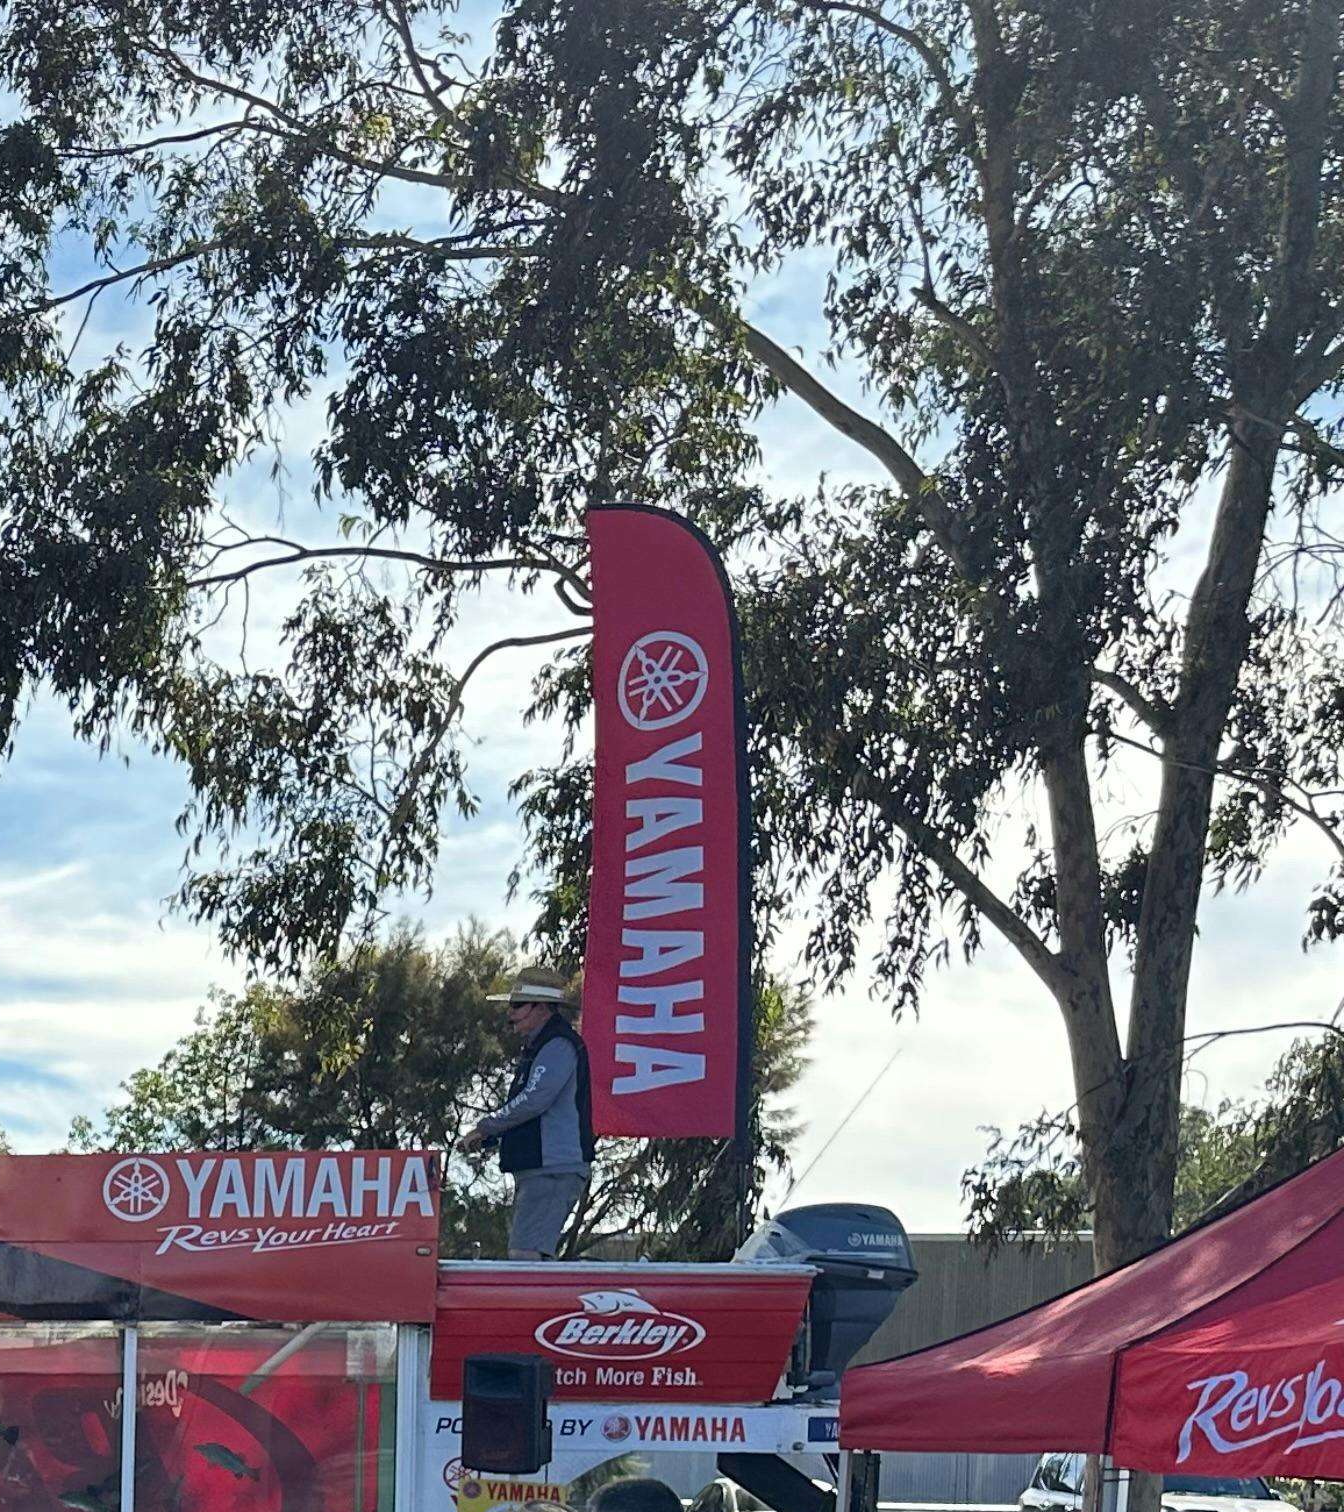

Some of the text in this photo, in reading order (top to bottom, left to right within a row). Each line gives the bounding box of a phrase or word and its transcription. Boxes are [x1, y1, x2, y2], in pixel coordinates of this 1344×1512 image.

[612, 731, 706, 1094] YAMAHA
[176, 1157, 434, 1219] YAMAHA
[156, 1220, 401, 1255] Revs Your Heart
[862, 1233, 904, 1247] YAMAHA
[554, 1318, 689, 1355] Berkley
[555, 1368, 587, 1385] tch
[596, 1367, 644, 1386] More
[560, 1416, 746, 1442] BY YAMAHA
[1176, 1370, 1304, 1464] Revs
[486, 1482, 562, 1502] YAMAHA
